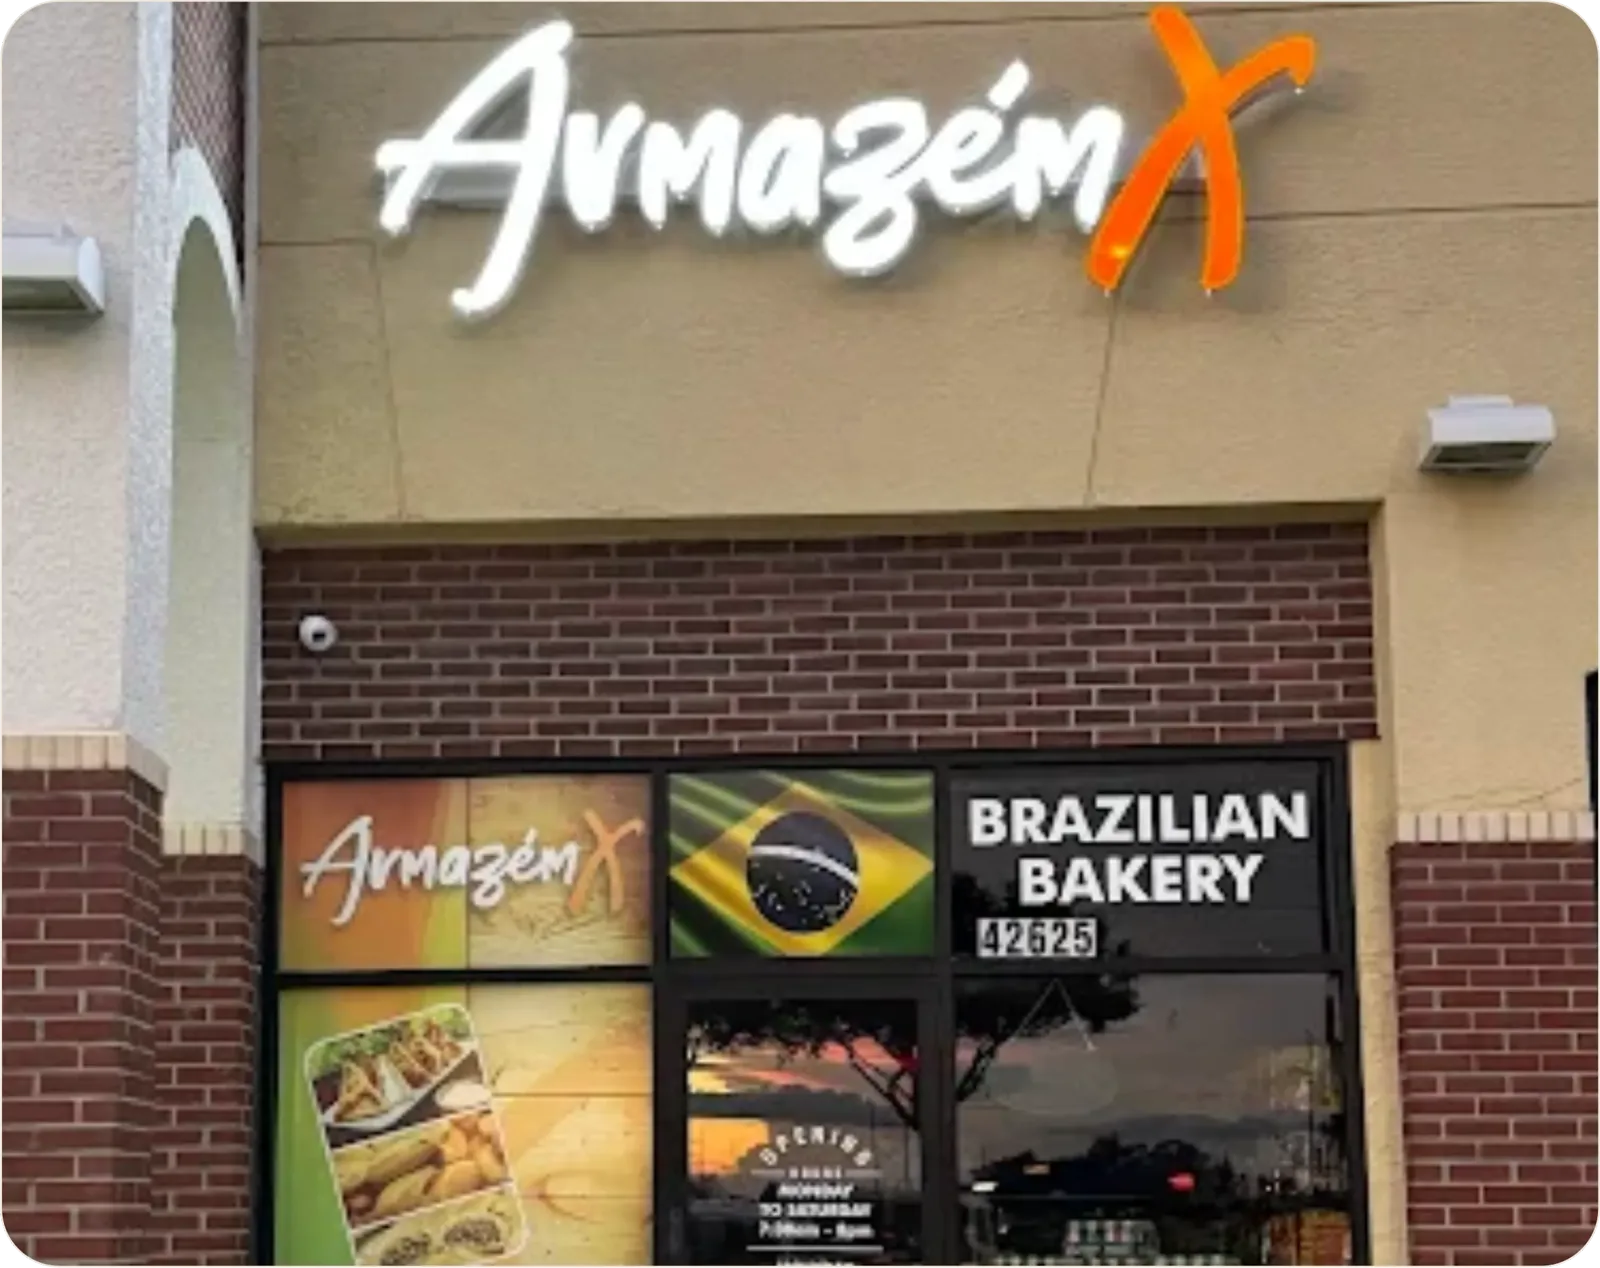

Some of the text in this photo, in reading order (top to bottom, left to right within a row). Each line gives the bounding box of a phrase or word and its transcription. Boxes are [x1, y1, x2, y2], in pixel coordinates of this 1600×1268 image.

[375, 3, 1317, 317] Armazém X
[968, 790, 1310, 846] BRAZILIAN
[300, 814, 579, 926] Armazém
[1018, 853, 1265, 907] BAKERY
[978, 918, 1097, 957] 42625
[758, 1125, 873, 1166] OPENING
[758, 1202, 873, 1218] TO SATURDAY
[776, 1183, 854, 1200] MONDAY
